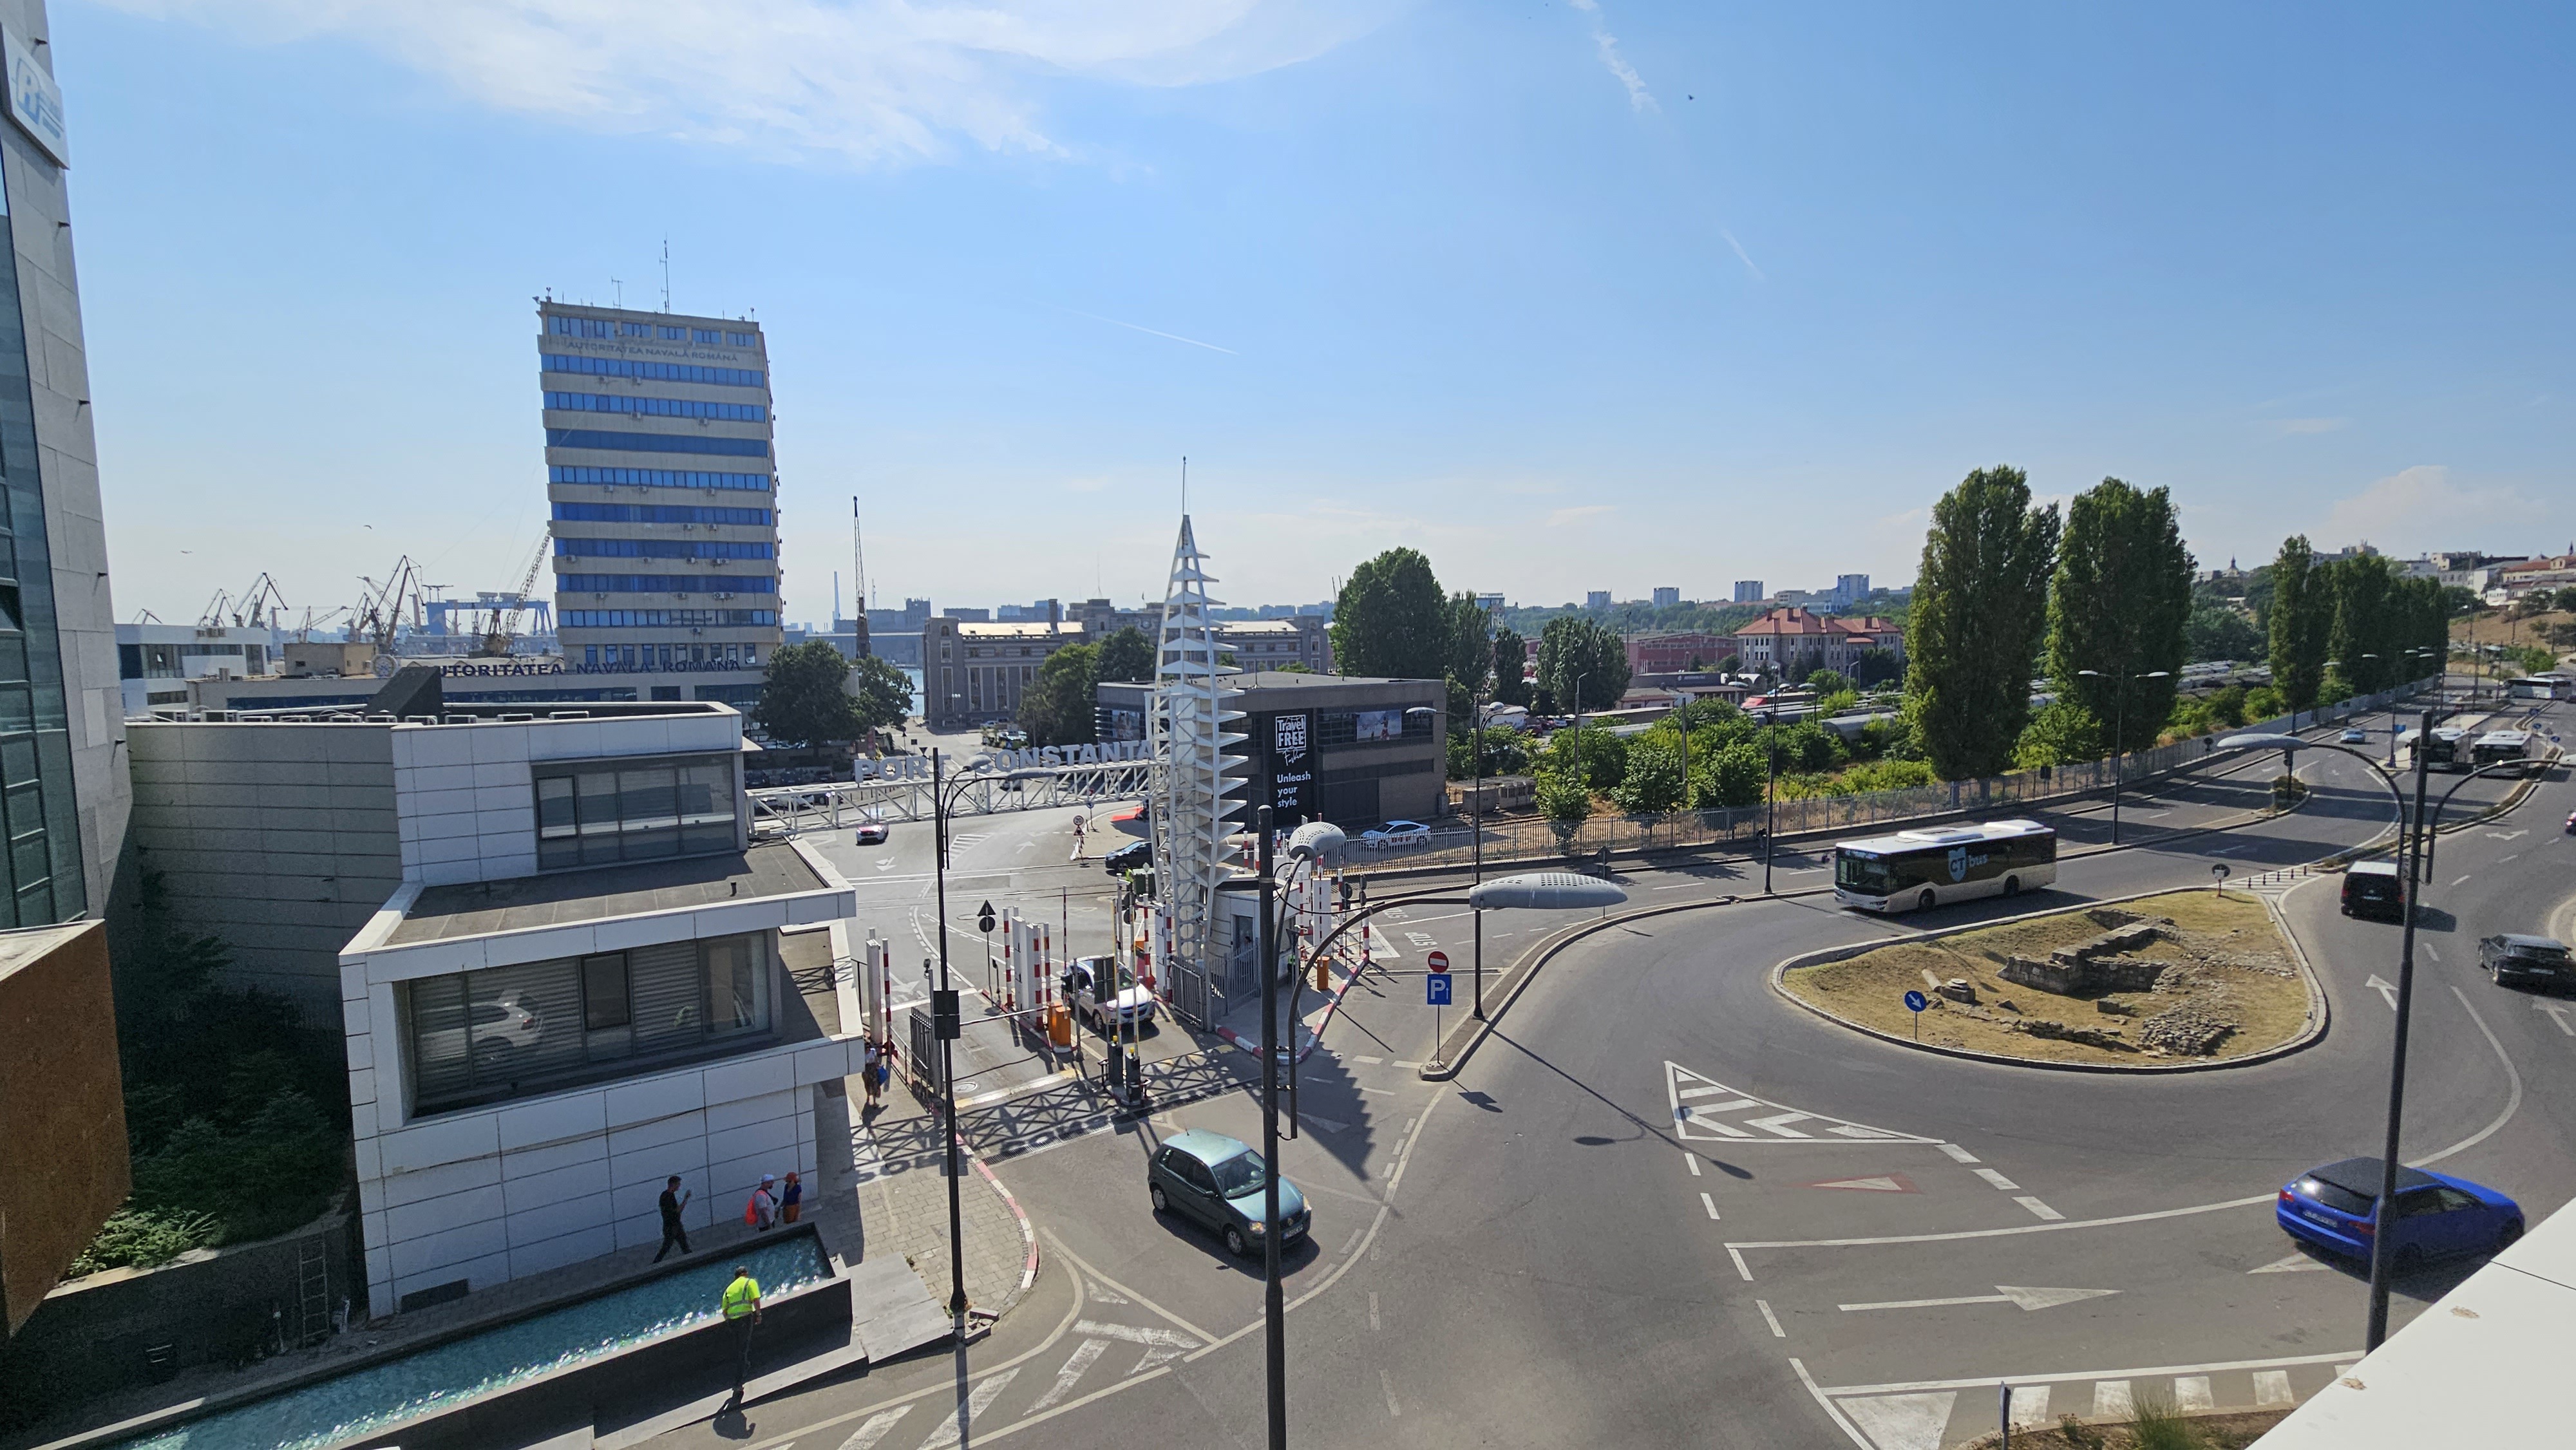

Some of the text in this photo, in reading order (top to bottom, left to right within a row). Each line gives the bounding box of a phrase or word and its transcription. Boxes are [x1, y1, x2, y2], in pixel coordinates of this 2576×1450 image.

[440, 663, 564, 677] UTORITATEA
[1277, 717, 1304, 731] Travel
[1278, 731, 1304, 747] FREE
[854, 754, 951, 784] PORT
[1277, 771, 1311, 783] Unleash
[1277, 786, 1298, 798] your
[1277, 796, 1298, 808] style
[1950, 854, 1989, 872] CT bus
[1430, 979, 1446, 1000] P
